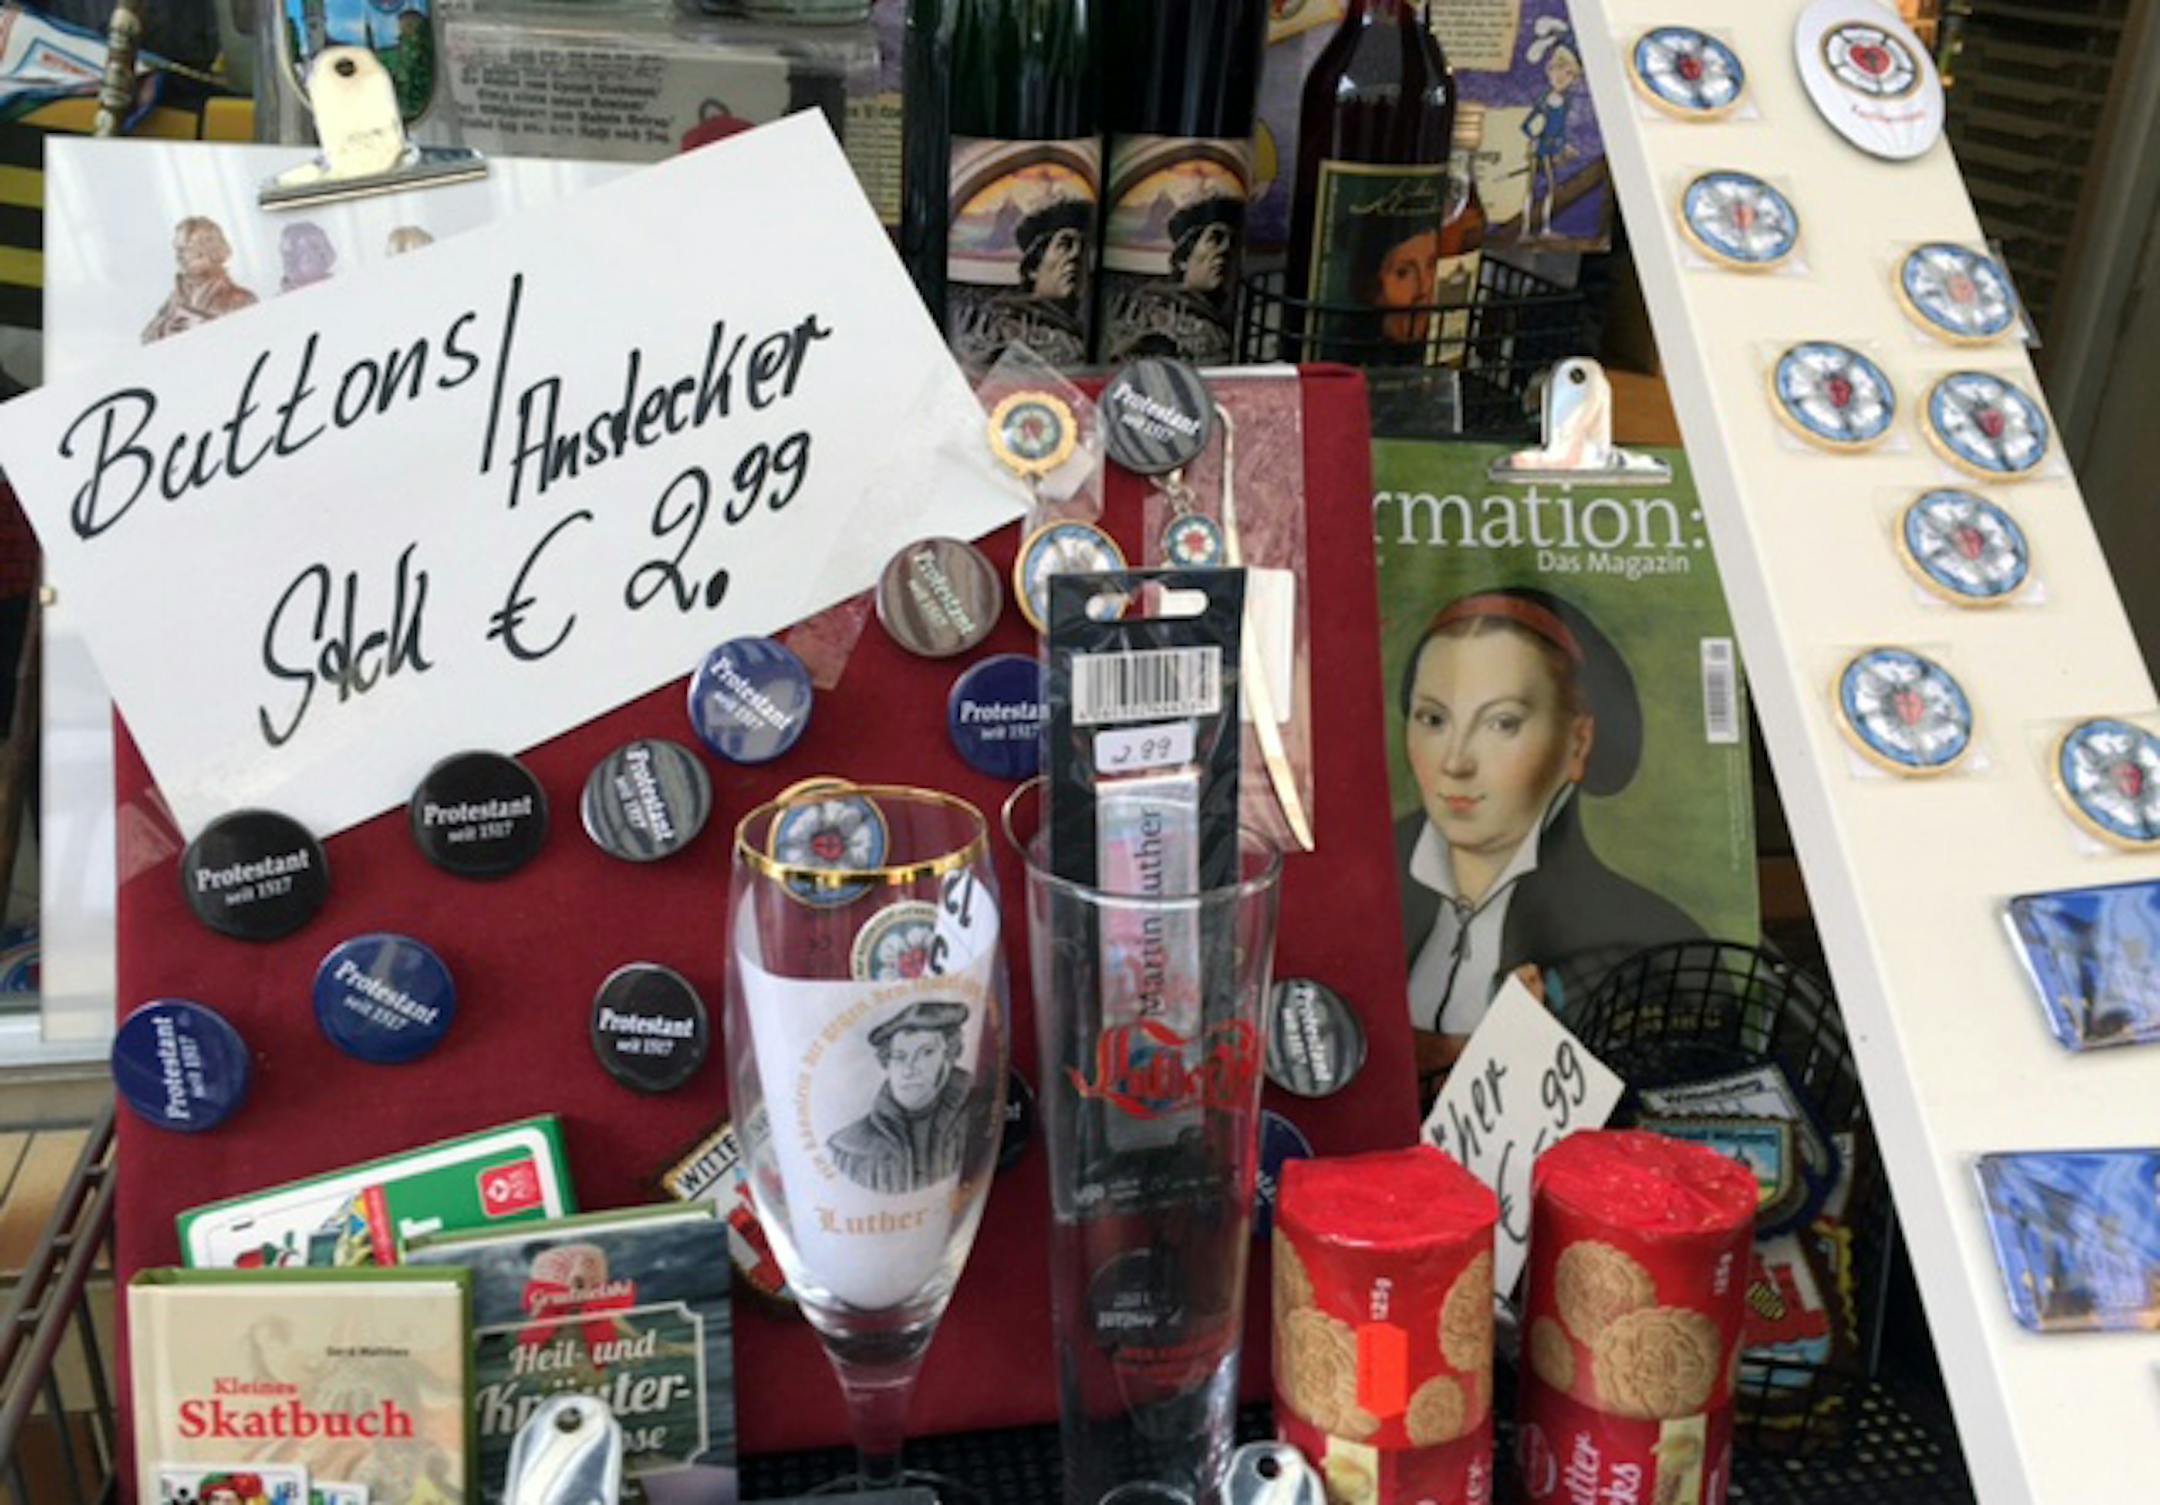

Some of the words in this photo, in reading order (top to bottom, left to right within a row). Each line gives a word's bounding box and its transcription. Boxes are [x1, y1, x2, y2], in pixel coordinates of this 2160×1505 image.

[1112, 381, 1200, 437] Protestant
[1537, 550, 1582, 573] Das
[1587, 549, 1691, 580] Magazin
[911, 549, 978, 635] Protestant
[710, 655, 796, 731] Protestant
[959, 699, 1052, 724] Protestan
[423, 794, 533, 828] Protestant
[626, 748, 676, 843] Protestant
[446, 825, 477, 844] seit
[478, 820, 515, 842] 1517
[195, 848, 310, 893] Protestant
[224, 888, 255, 907] seit
[258, 875, 293, 900] 1517
[1139, 915, 1167, 1019] Martin
[334, 958, 441, 1027] Protestant
[343, 992, 372, 1019] seit
[598, 1005, 695, 1038] Protestant
[1293, 986, 1334, 1082] Protestant
[615, 1037, 642, 1055] seit
[151, 1016, 192, 1121] Protestant
[814, 1203, 931, 1236] Luther
[508, 1338, 583, 1376] Heil-
[592, 1327, 657, 1367] und
[213, 1377, 299, 1397] Kleines
[178, 1398, 415, 1440] Skatbuch
